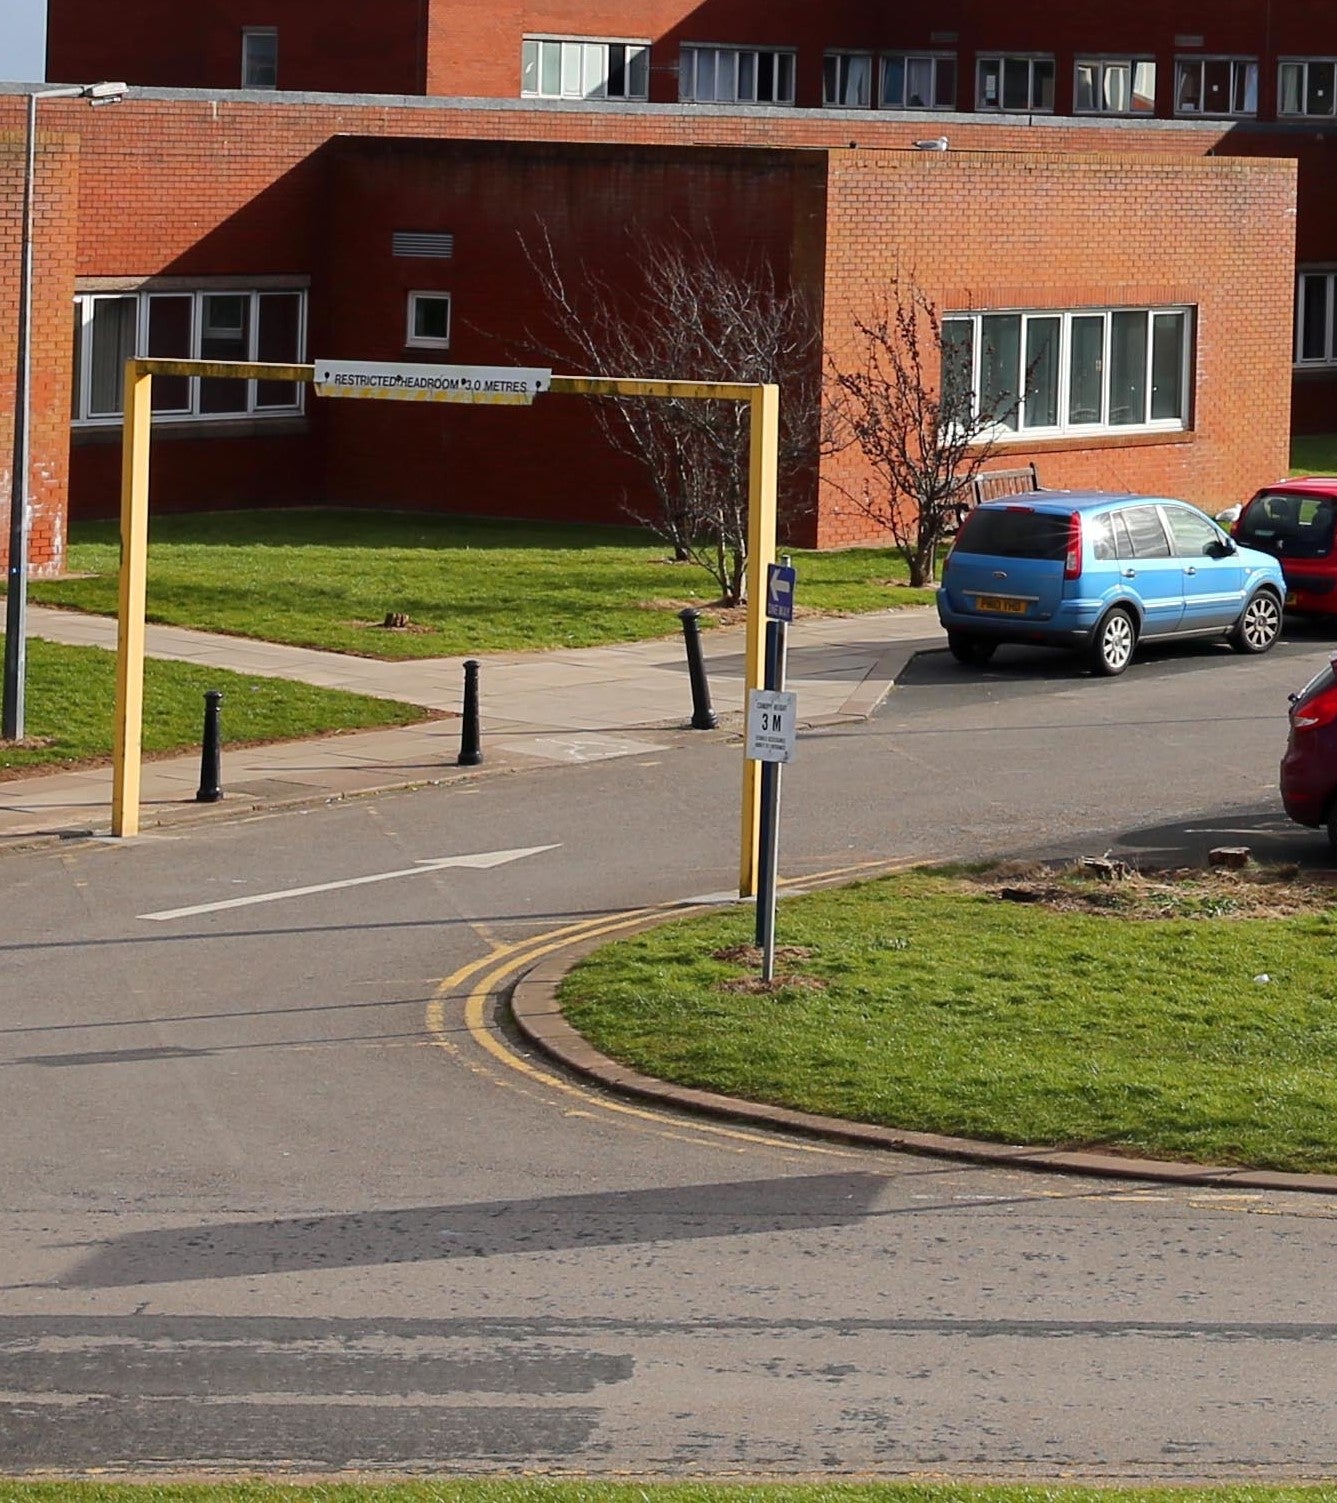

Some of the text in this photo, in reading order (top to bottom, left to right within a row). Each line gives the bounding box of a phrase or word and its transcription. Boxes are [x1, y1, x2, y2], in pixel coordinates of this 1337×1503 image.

[335, 374, 396, 387] RESTRICTED
[401, 377, 459, 390] HEADROOM
[484, 381, 527, 393] METRES
[762, 713, 781, 732] 3 M
